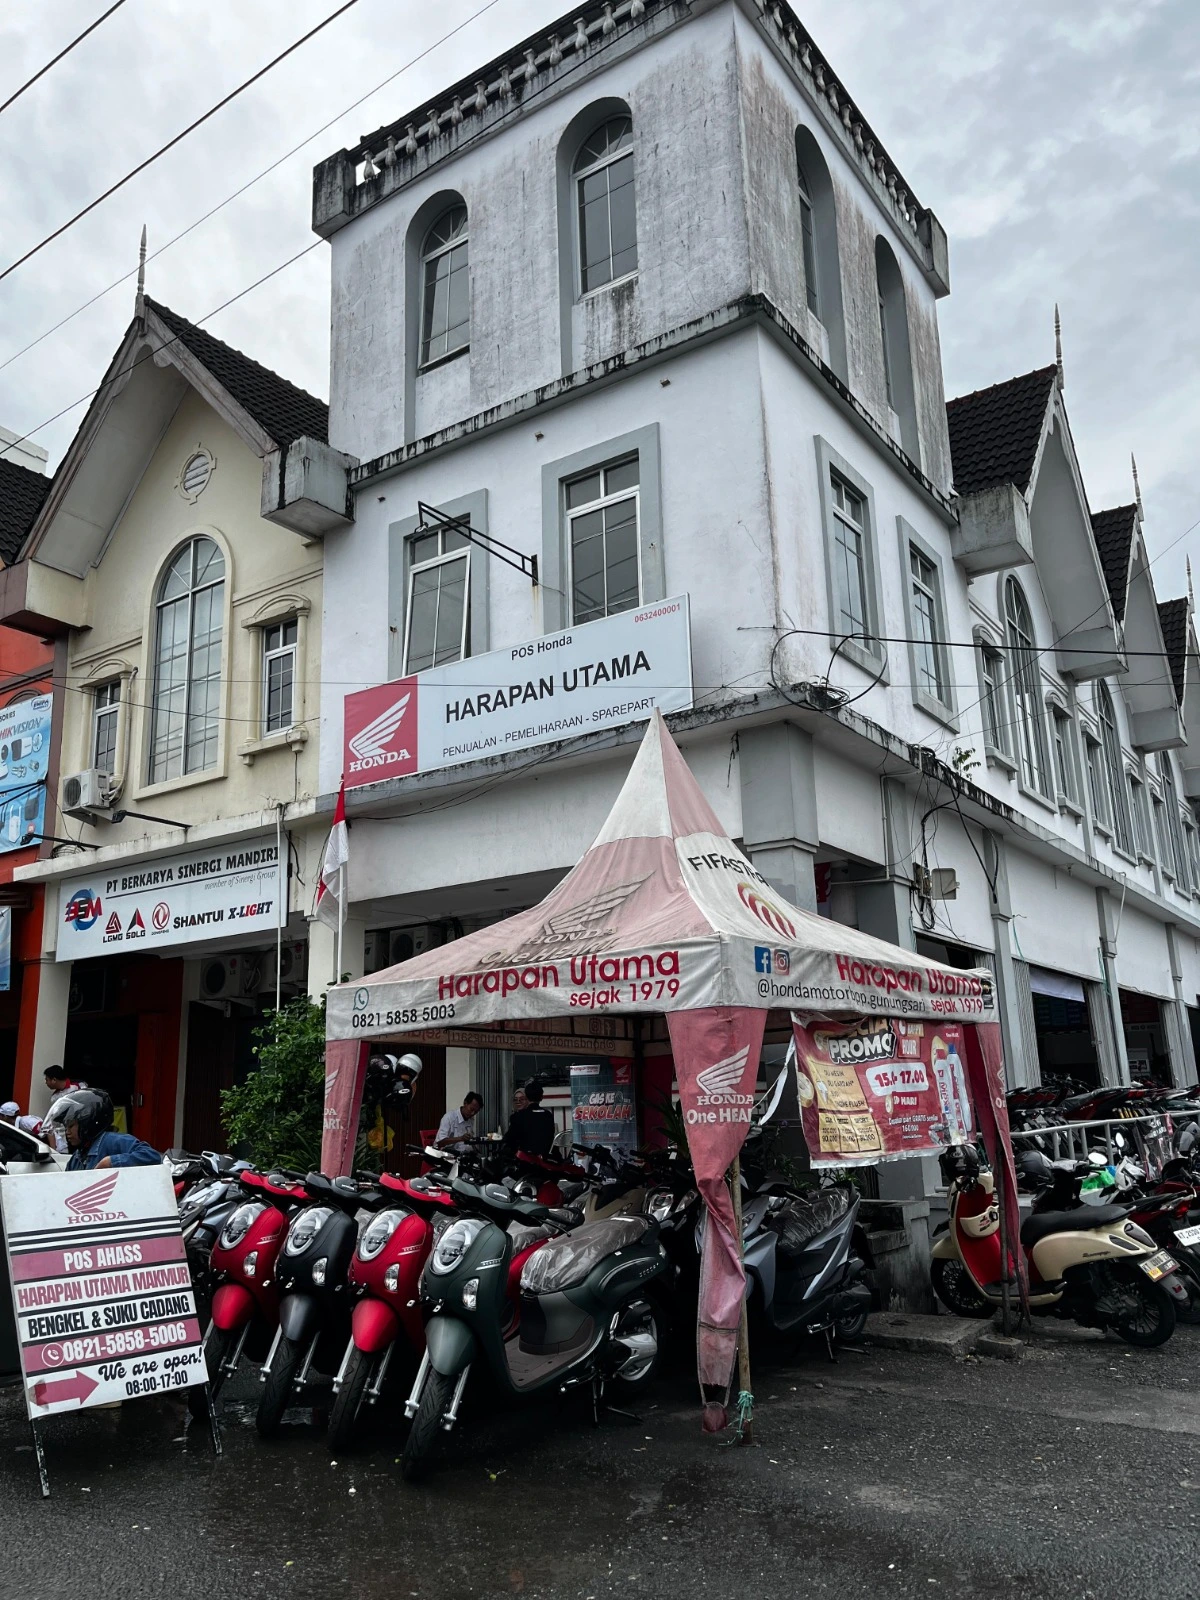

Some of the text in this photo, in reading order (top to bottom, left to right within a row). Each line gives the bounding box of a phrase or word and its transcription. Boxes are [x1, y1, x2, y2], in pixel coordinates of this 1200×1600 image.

[634, 602, 681, 624] 0632400001
[511, 635, 573, 661] POS Honda
[445, 650, 651, 724] HARAPAN UTAMA
[0, 717, 42, 741] HIKVISION
[442, 736, 497, 758] PENJUALAN
[505, 717, 583, 743] PEMELIHARAAN
[592, 696, 657, 722] SPAREPART
[349, 748, 411, 773] HONDA
[106, 846, 278, 894] PT BERKARYA SINERGI MANDIRI
[204, 870, 276, 891] member of Sinergi Group
[173, 900, 273, 929] SHANTUI X-LIGHT
[438, 950, 680, 1000] Harapan Utama
[835, 953, 982, 996] Harapan Utama
[569, 978, 680, 1009] sejak 1979
[931, 997, 957, 1016] sejak
[960, 997, 983, 1013] 1979
[352, 1003, 456, 1029] 0821 5858 5003
[899, 1070, 925, 1084] 17.00
[589, 1092, 616, 1105] GAS KE
[696, 1094, 754, 1106] HONDA
[573, 1104, 633, 1121] SEKOLAH
[686, 1108, 717, 1124] One
[67, 1211, 129, 1225] HONDA
[63, 1243, 143, 1272] POS AHASS
[18, 1266, 190, 1309] HARAPAN UTAMA MAKMUR
[28, 1294, 190, 1339] BENGKEL & SUKU CADANG
[63, 1322, 187, 1362] 0821-5858-5006
[98, 1346, 203, 1382] We are open!
[125, 1369, 188, 1396] 08:00-17:00
